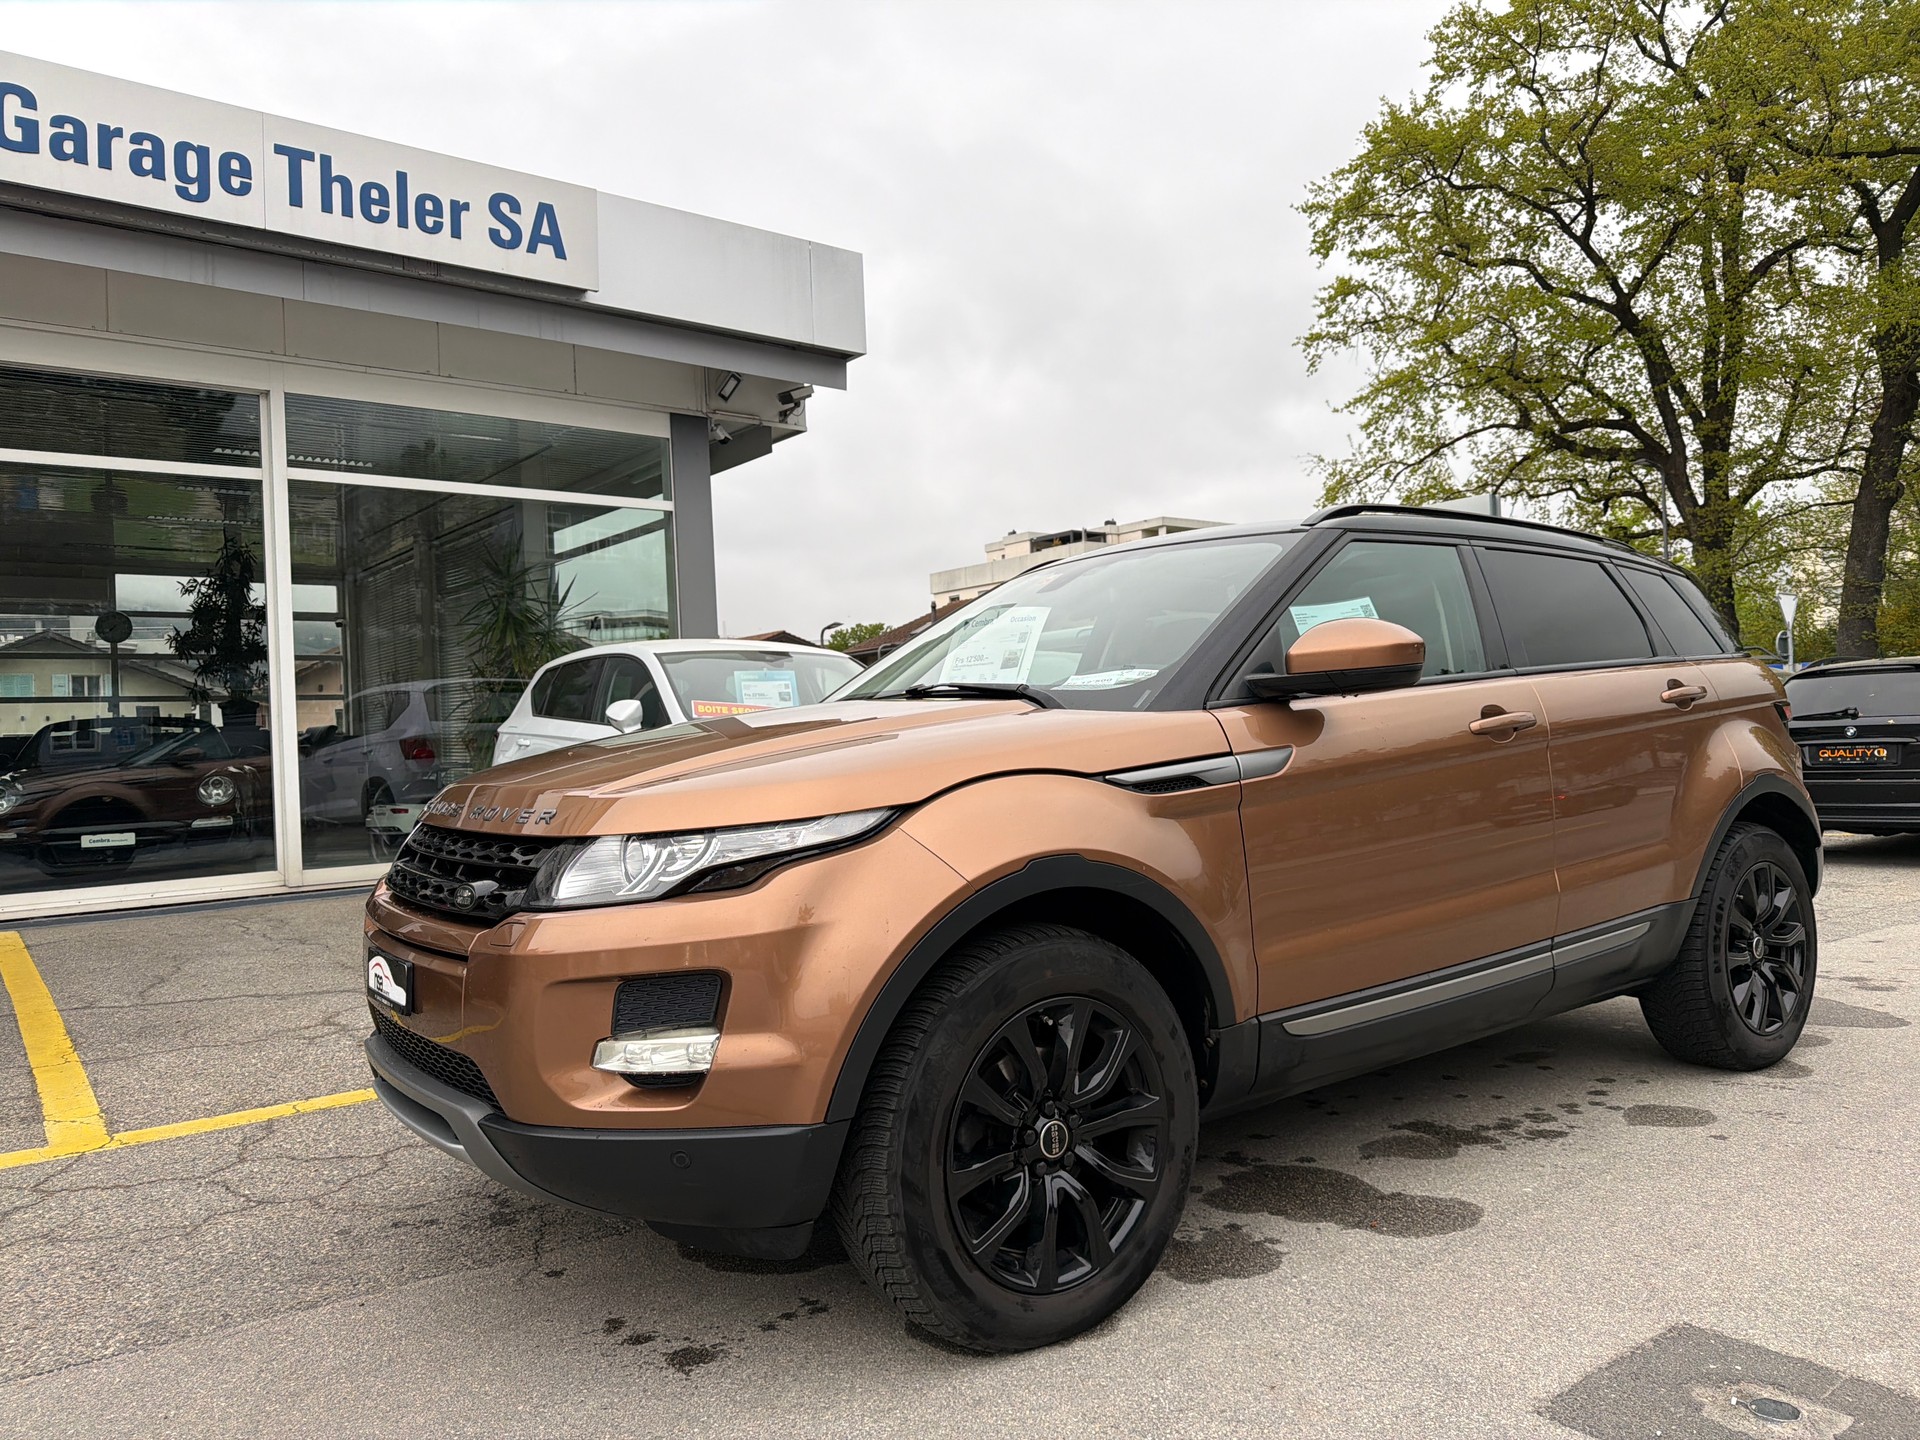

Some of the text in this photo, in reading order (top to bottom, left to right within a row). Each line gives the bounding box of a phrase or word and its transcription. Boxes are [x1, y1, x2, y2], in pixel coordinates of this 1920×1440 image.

[0, 82, 568, 260] Garage Theler SA
[1010, 614, 1037, 623] Occasion
[697, 704, 729, 714] BOITE
[1818, 748, 1874, 758] QUALITY
[468, 804, 558, 826] ROVER
